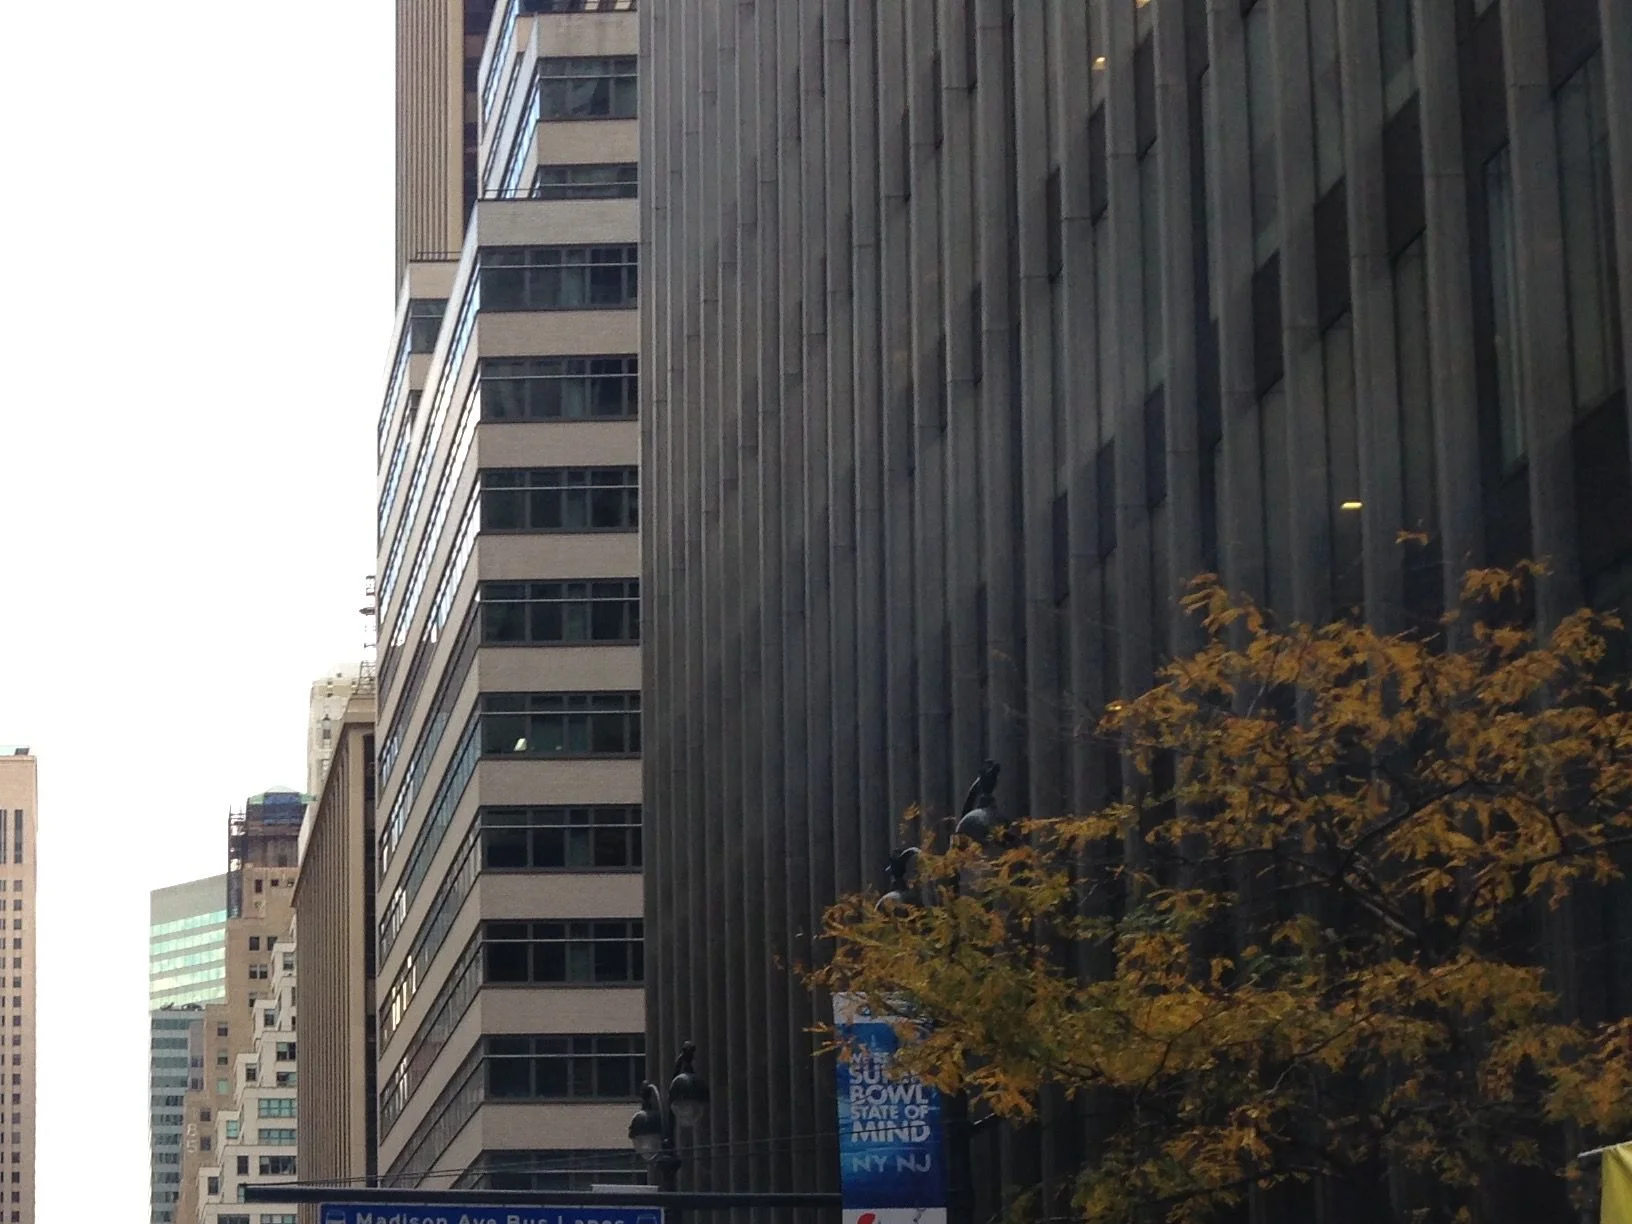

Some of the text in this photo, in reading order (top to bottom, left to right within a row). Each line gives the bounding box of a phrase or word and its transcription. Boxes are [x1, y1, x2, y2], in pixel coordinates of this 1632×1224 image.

[849, 1084, 929, 1105] BOWL
[850, 1105, 929, 1120] STATE OF
[851, 1123, 931, 1143] MIND
[852, 1154, 932, 1173] NY NJ
